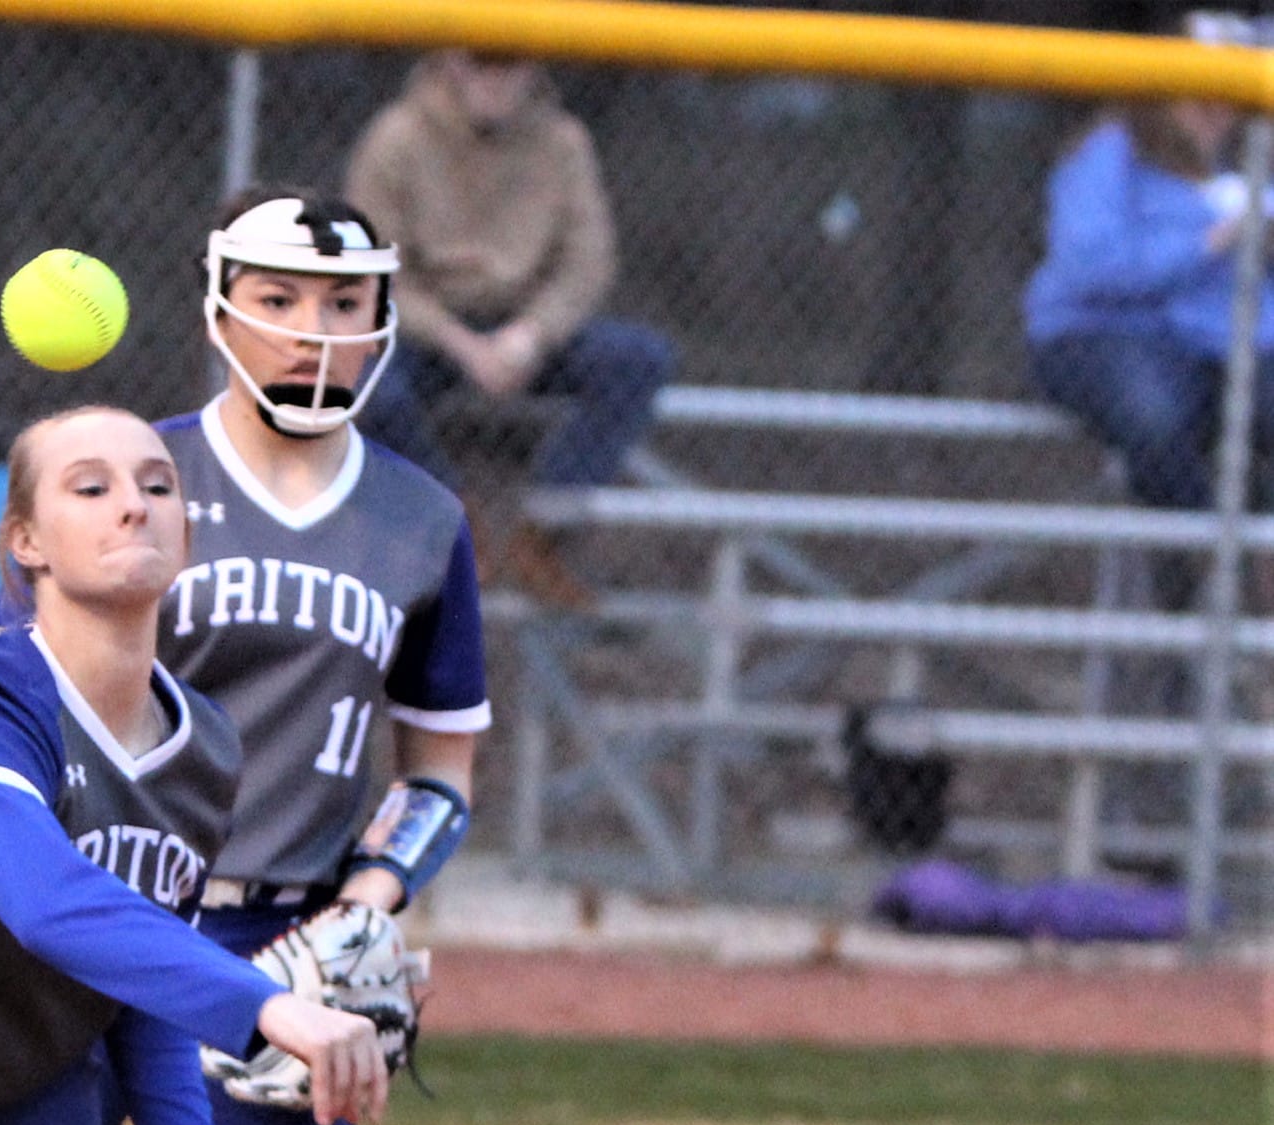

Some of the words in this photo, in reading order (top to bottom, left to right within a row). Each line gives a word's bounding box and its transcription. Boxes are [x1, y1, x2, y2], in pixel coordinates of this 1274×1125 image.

[169, 556, 405, 671] TRITON
[314, 695, 372, 778] 11
[72, 823, 206, 909] ITON
